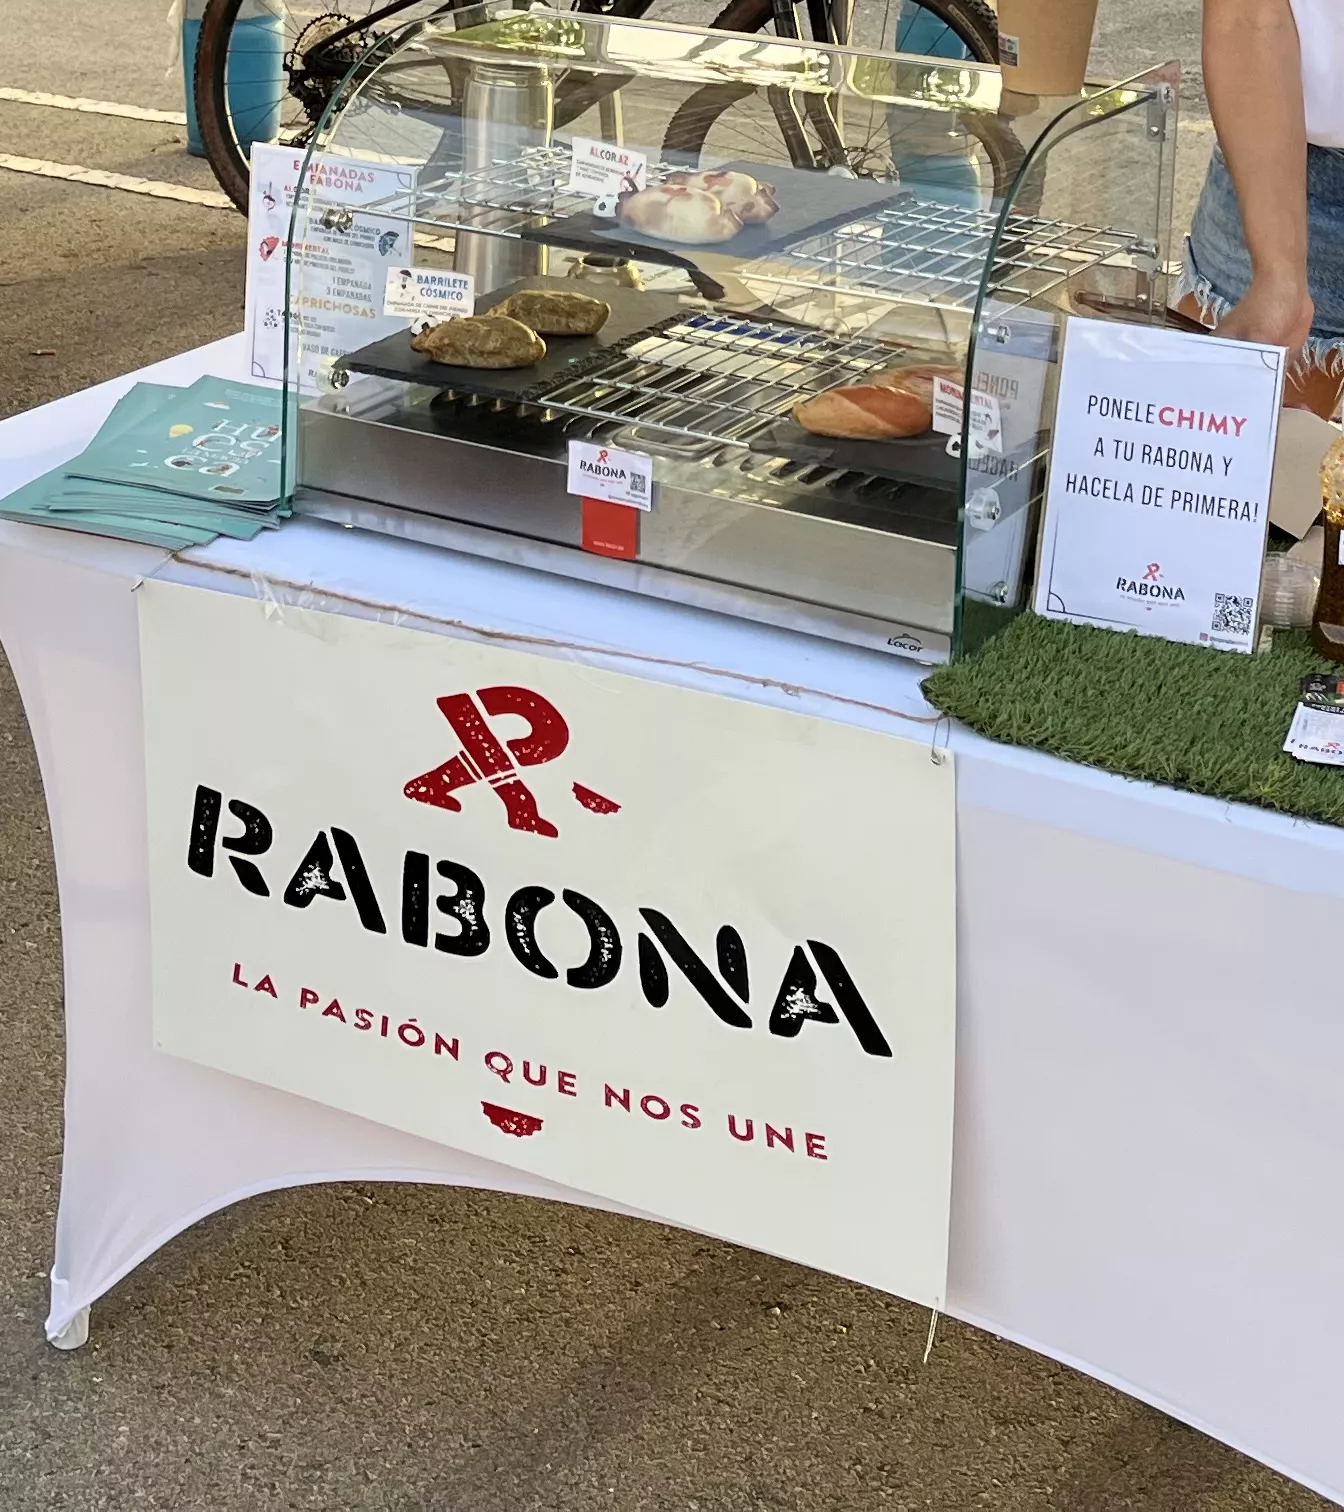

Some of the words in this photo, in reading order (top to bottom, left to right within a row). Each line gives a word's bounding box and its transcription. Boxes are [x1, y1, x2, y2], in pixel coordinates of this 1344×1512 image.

[416, 273, 469, 290] BARRILETE
[420, 287, 463, 302] CÓSMICO
[1087, 394, 1157, 425] PONELE
[1158, 405, 1248, 438] CHIMY
[579, 459, 627, 480] RABONA
[1094, 437, 1105, 458] A
[1113, 439, 1135, 461] TU
[1141, 444, 1214, 475] RABONA
[1222, 455, 1234, 477] Y
[1065, 472, 1134, 504] HACELA
[1141, 485, 1164, 508] DE
[1170, 490, 1260, 523] PRIMERA!
[1116, 576, 1186, 602] RABONA
[887, 638, 923, 653] Lacor
[187, 784, 894, 1058] RABONA
[232, 962, 278, 1000] LA
[299, 986, 461, 1062] PASIÓN
[484, 1050, 578, 1098] QUE
[604, 1083, 703, 1130] NOS
[728, 1114, 828, 1161] UNE
